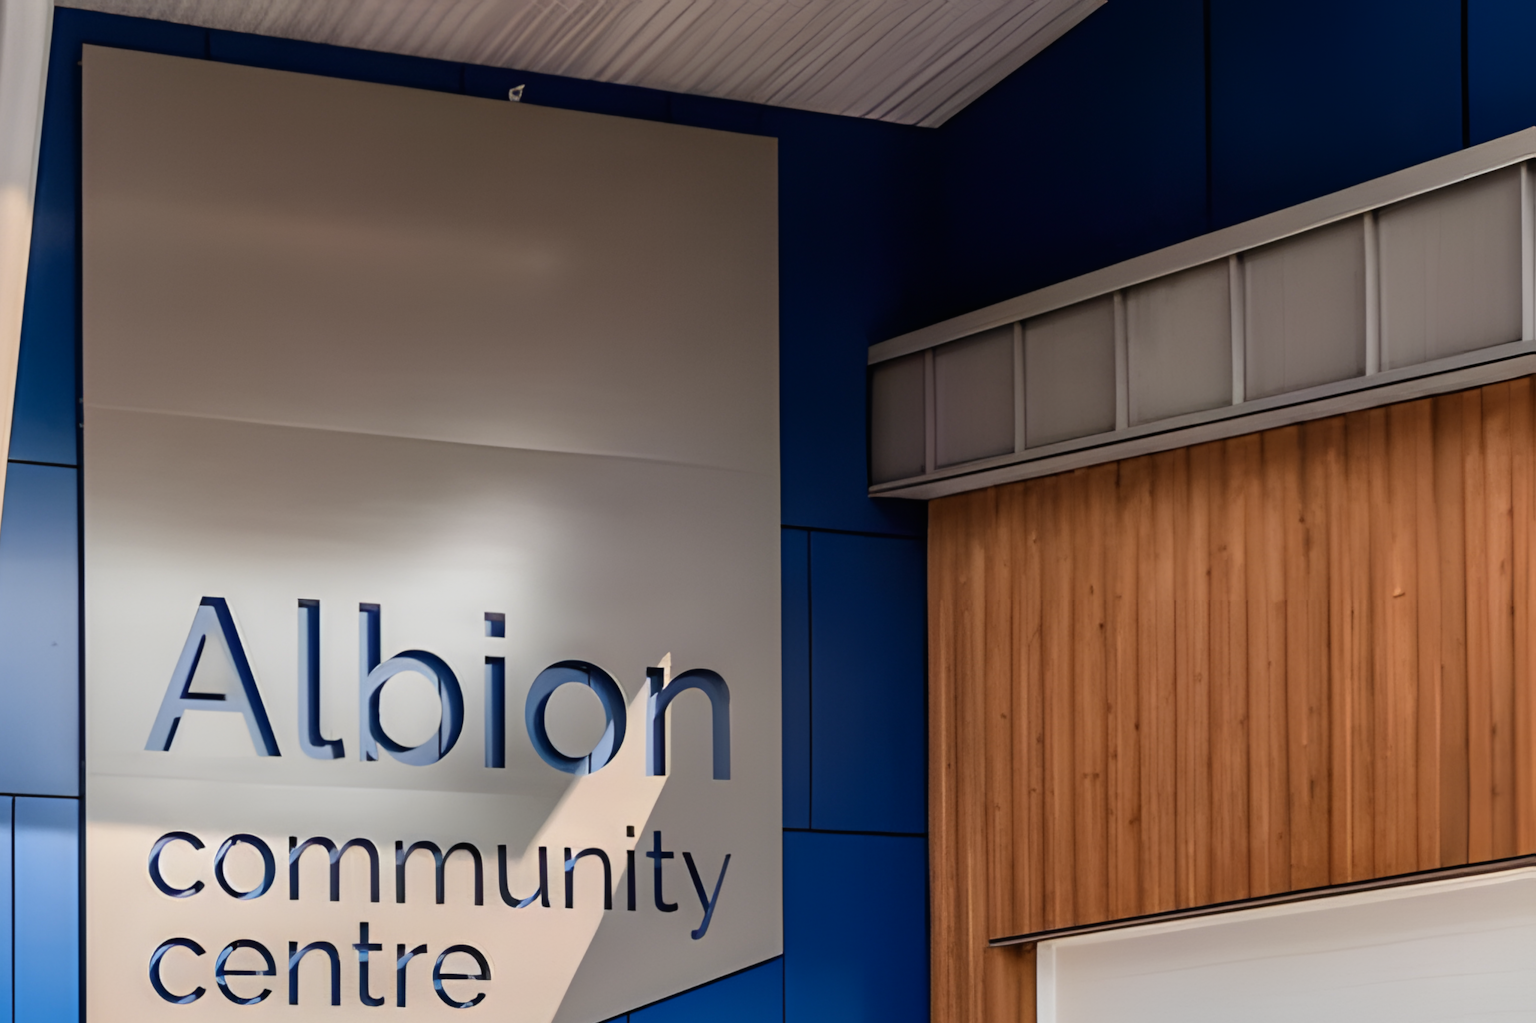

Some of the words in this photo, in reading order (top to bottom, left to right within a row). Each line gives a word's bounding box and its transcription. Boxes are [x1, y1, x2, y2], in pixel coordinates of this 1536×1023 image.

[144, 596, 731, 780] Albion
[148, 826, 731, 940] community
[148, 922, 492, 1009] centre
